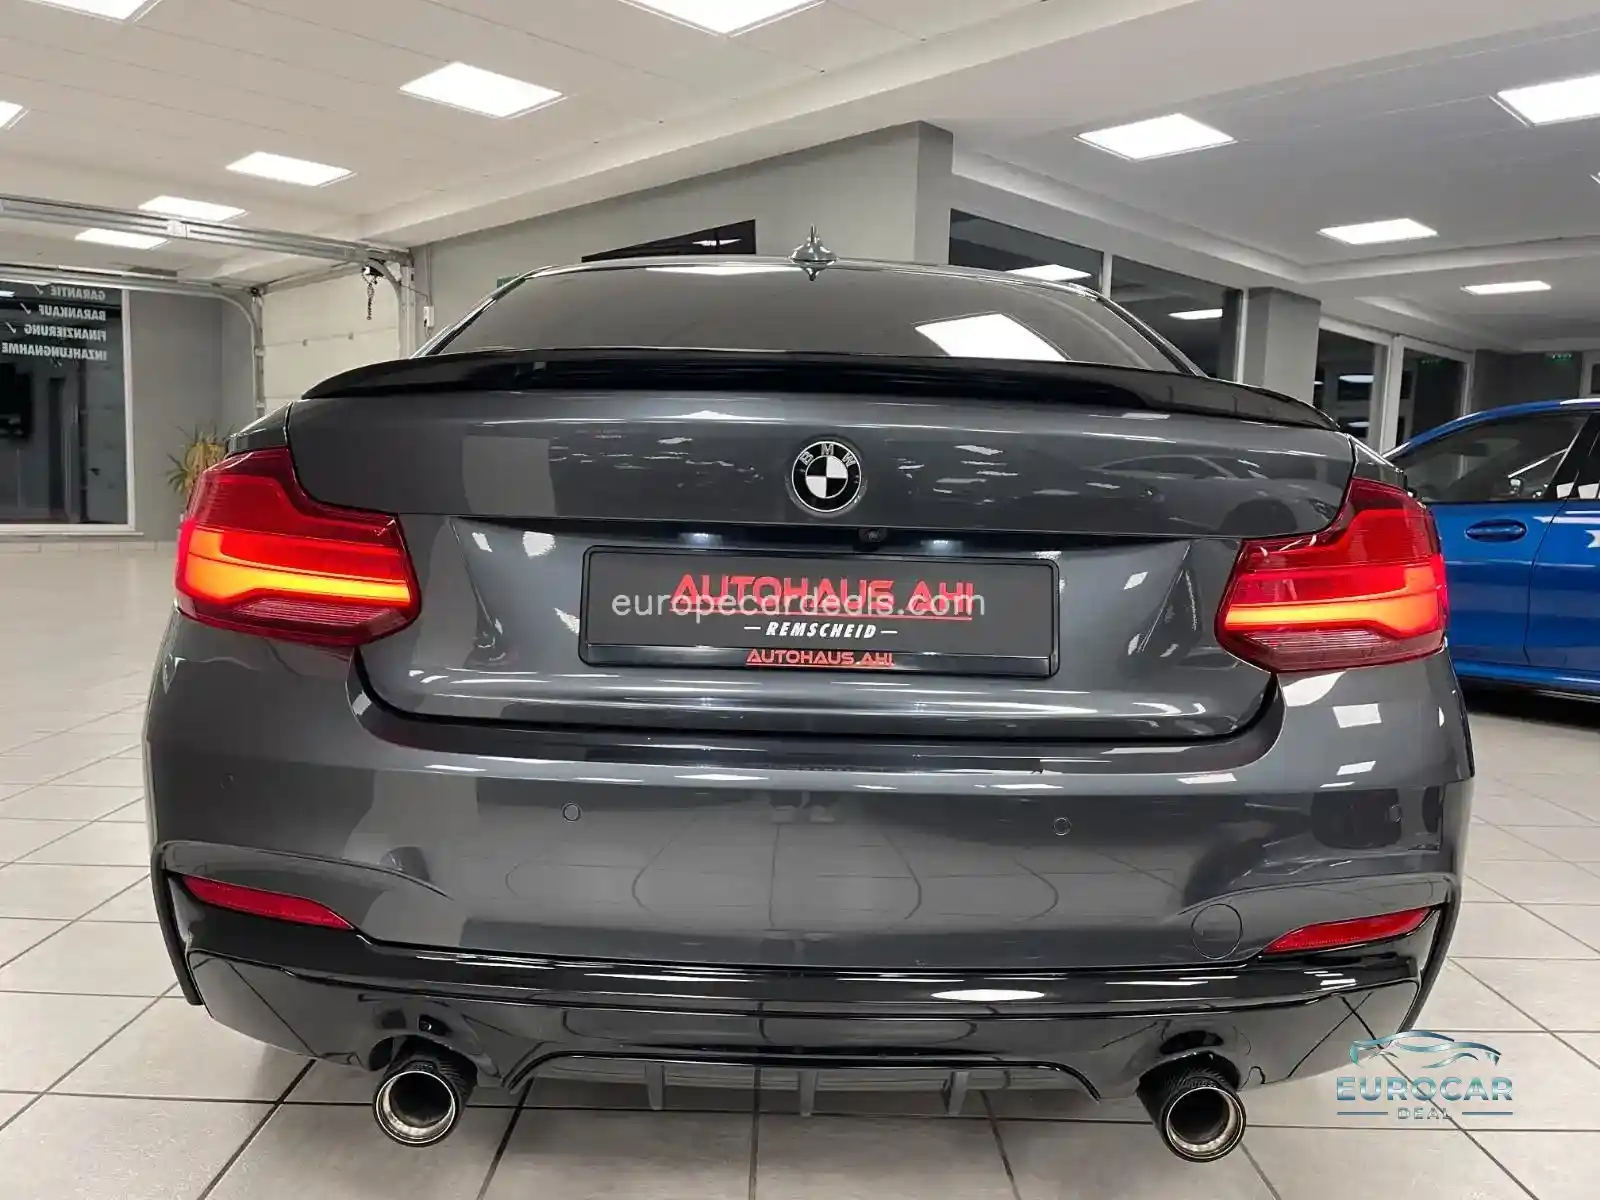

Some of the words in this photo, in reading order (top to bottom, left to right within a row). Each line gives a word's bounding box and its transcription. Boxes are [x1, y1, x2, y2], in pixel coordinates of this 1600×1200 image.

[799, 443, 857, 468] BMW
[669, 573, 895, 611] AUTOHAUS
[766, 621, 877, 639] REMSCHEID
[747, 649, 855, 665] AUTOHAUS
